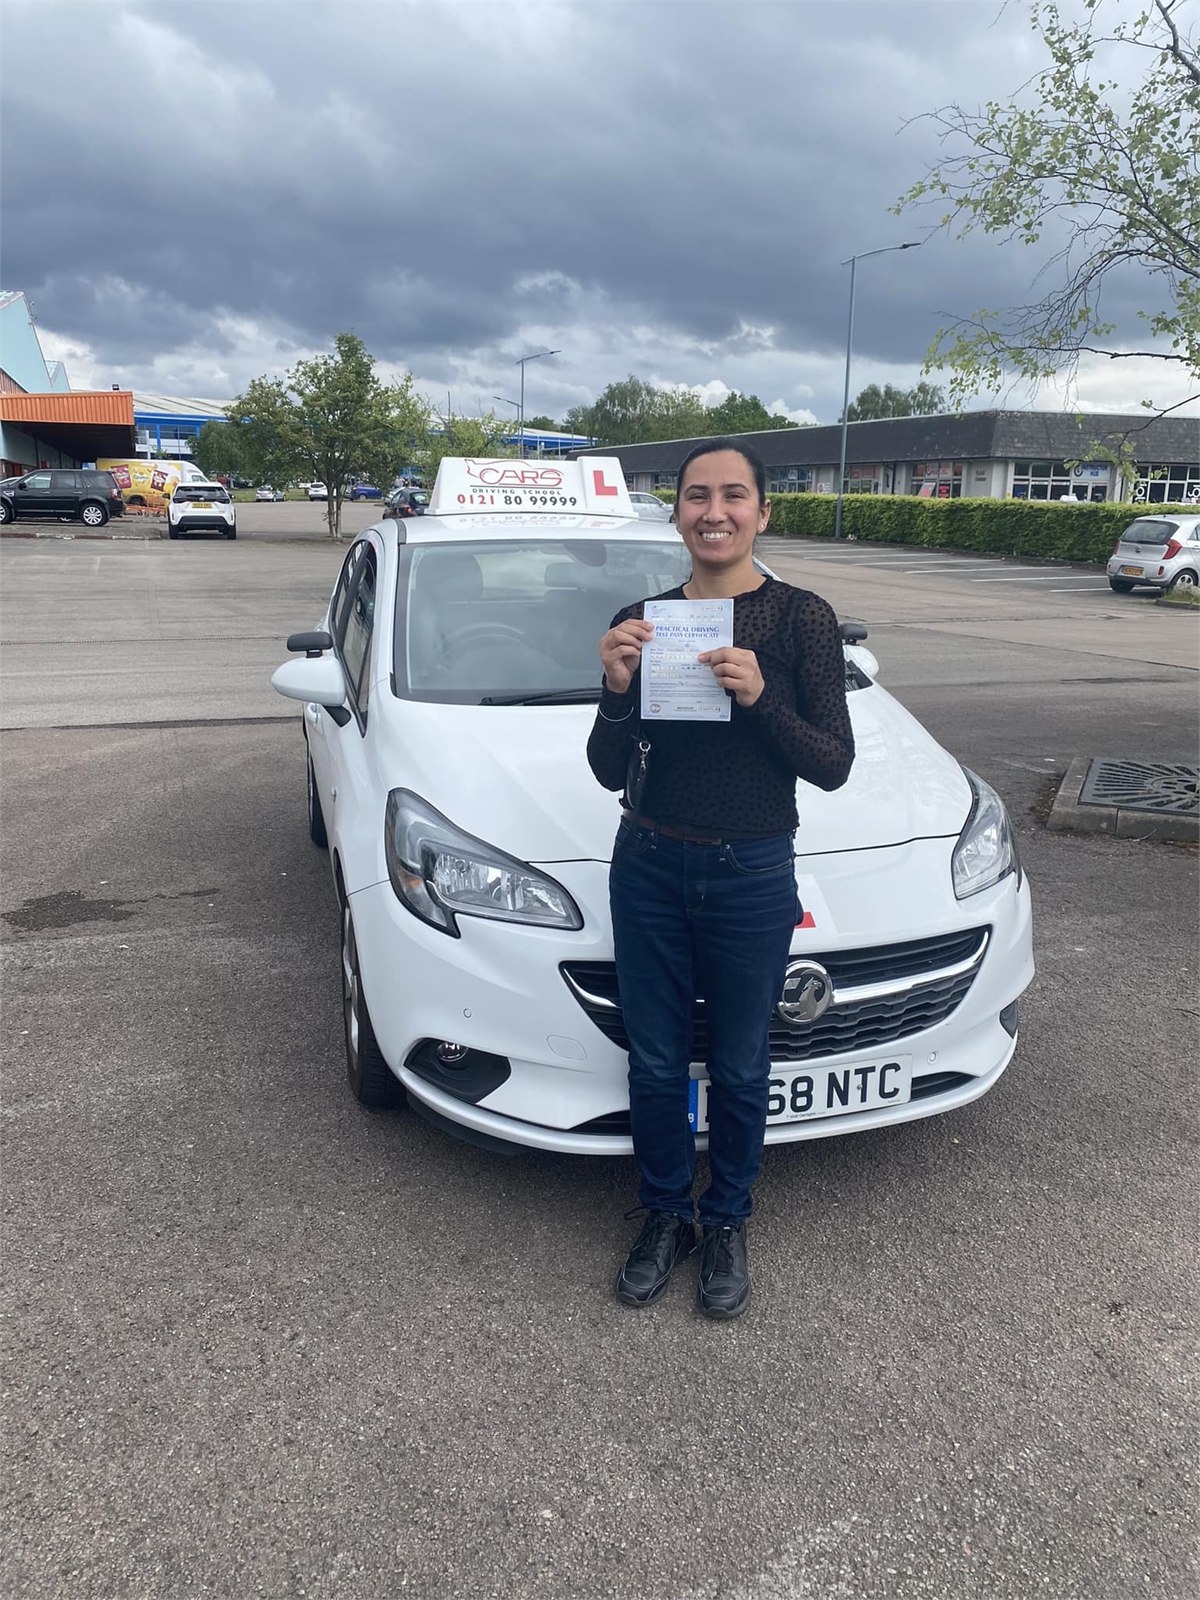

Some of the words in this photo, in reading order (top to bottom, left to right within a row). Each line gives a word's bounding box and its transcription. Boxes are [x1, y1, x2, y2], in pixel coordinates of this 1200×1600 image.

[479, 468, 563, 486] CARS
[593, 470, 618, 496] L
[457, 494, 495, 505] 0121
[504, 495, 522, 506] 80
[530, 496, 577, 506] 99999
[767, 1076, 814, 1116] 68
[827, 1062, 901, 1108] NTC
